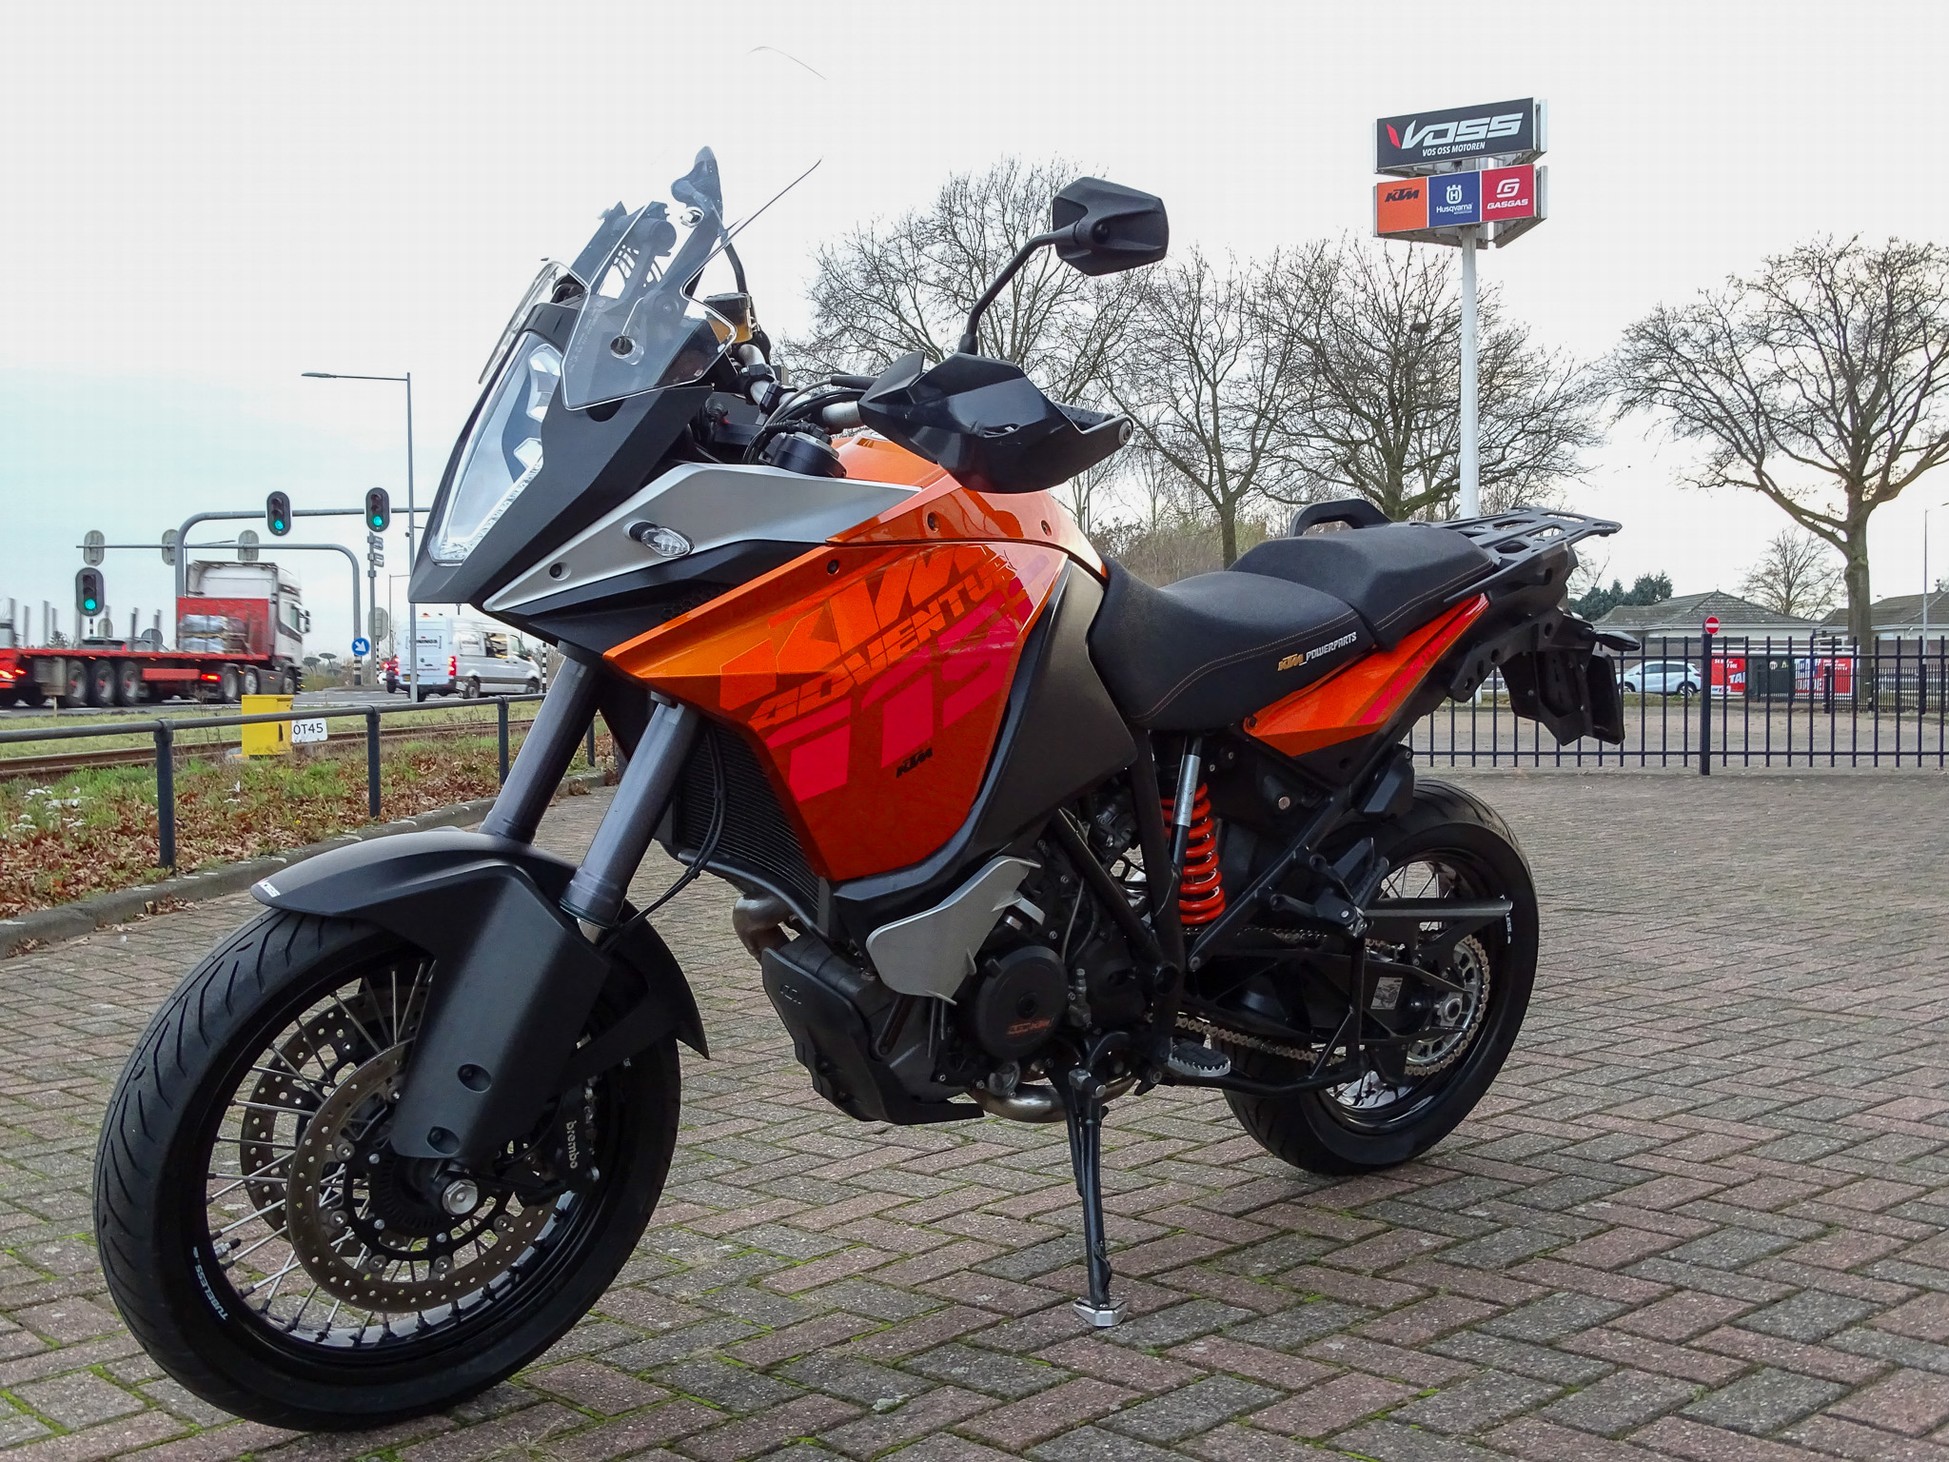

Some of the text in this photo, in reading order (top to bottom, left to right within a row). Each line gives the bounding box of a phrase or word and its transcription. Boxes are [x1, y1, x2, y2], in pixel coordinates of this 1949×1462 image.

[1401, 112, 1524, 150] VOSS
[1422, 141, 1486, 157] VOS OSS MOTOREN
[1385, 188, 1420, 202] KTM
[1436, 203, 1473, 214] Husqvarna
[1487, 199, 1529, 210] GASGAS
[1277, 631, 1358, 672] KTM POWERPARTS
[896, 748, 933, 778] KTM
[566, 1120, 580, 1169] brembo
[195, 1264, 228, 1320] TUBELESS
